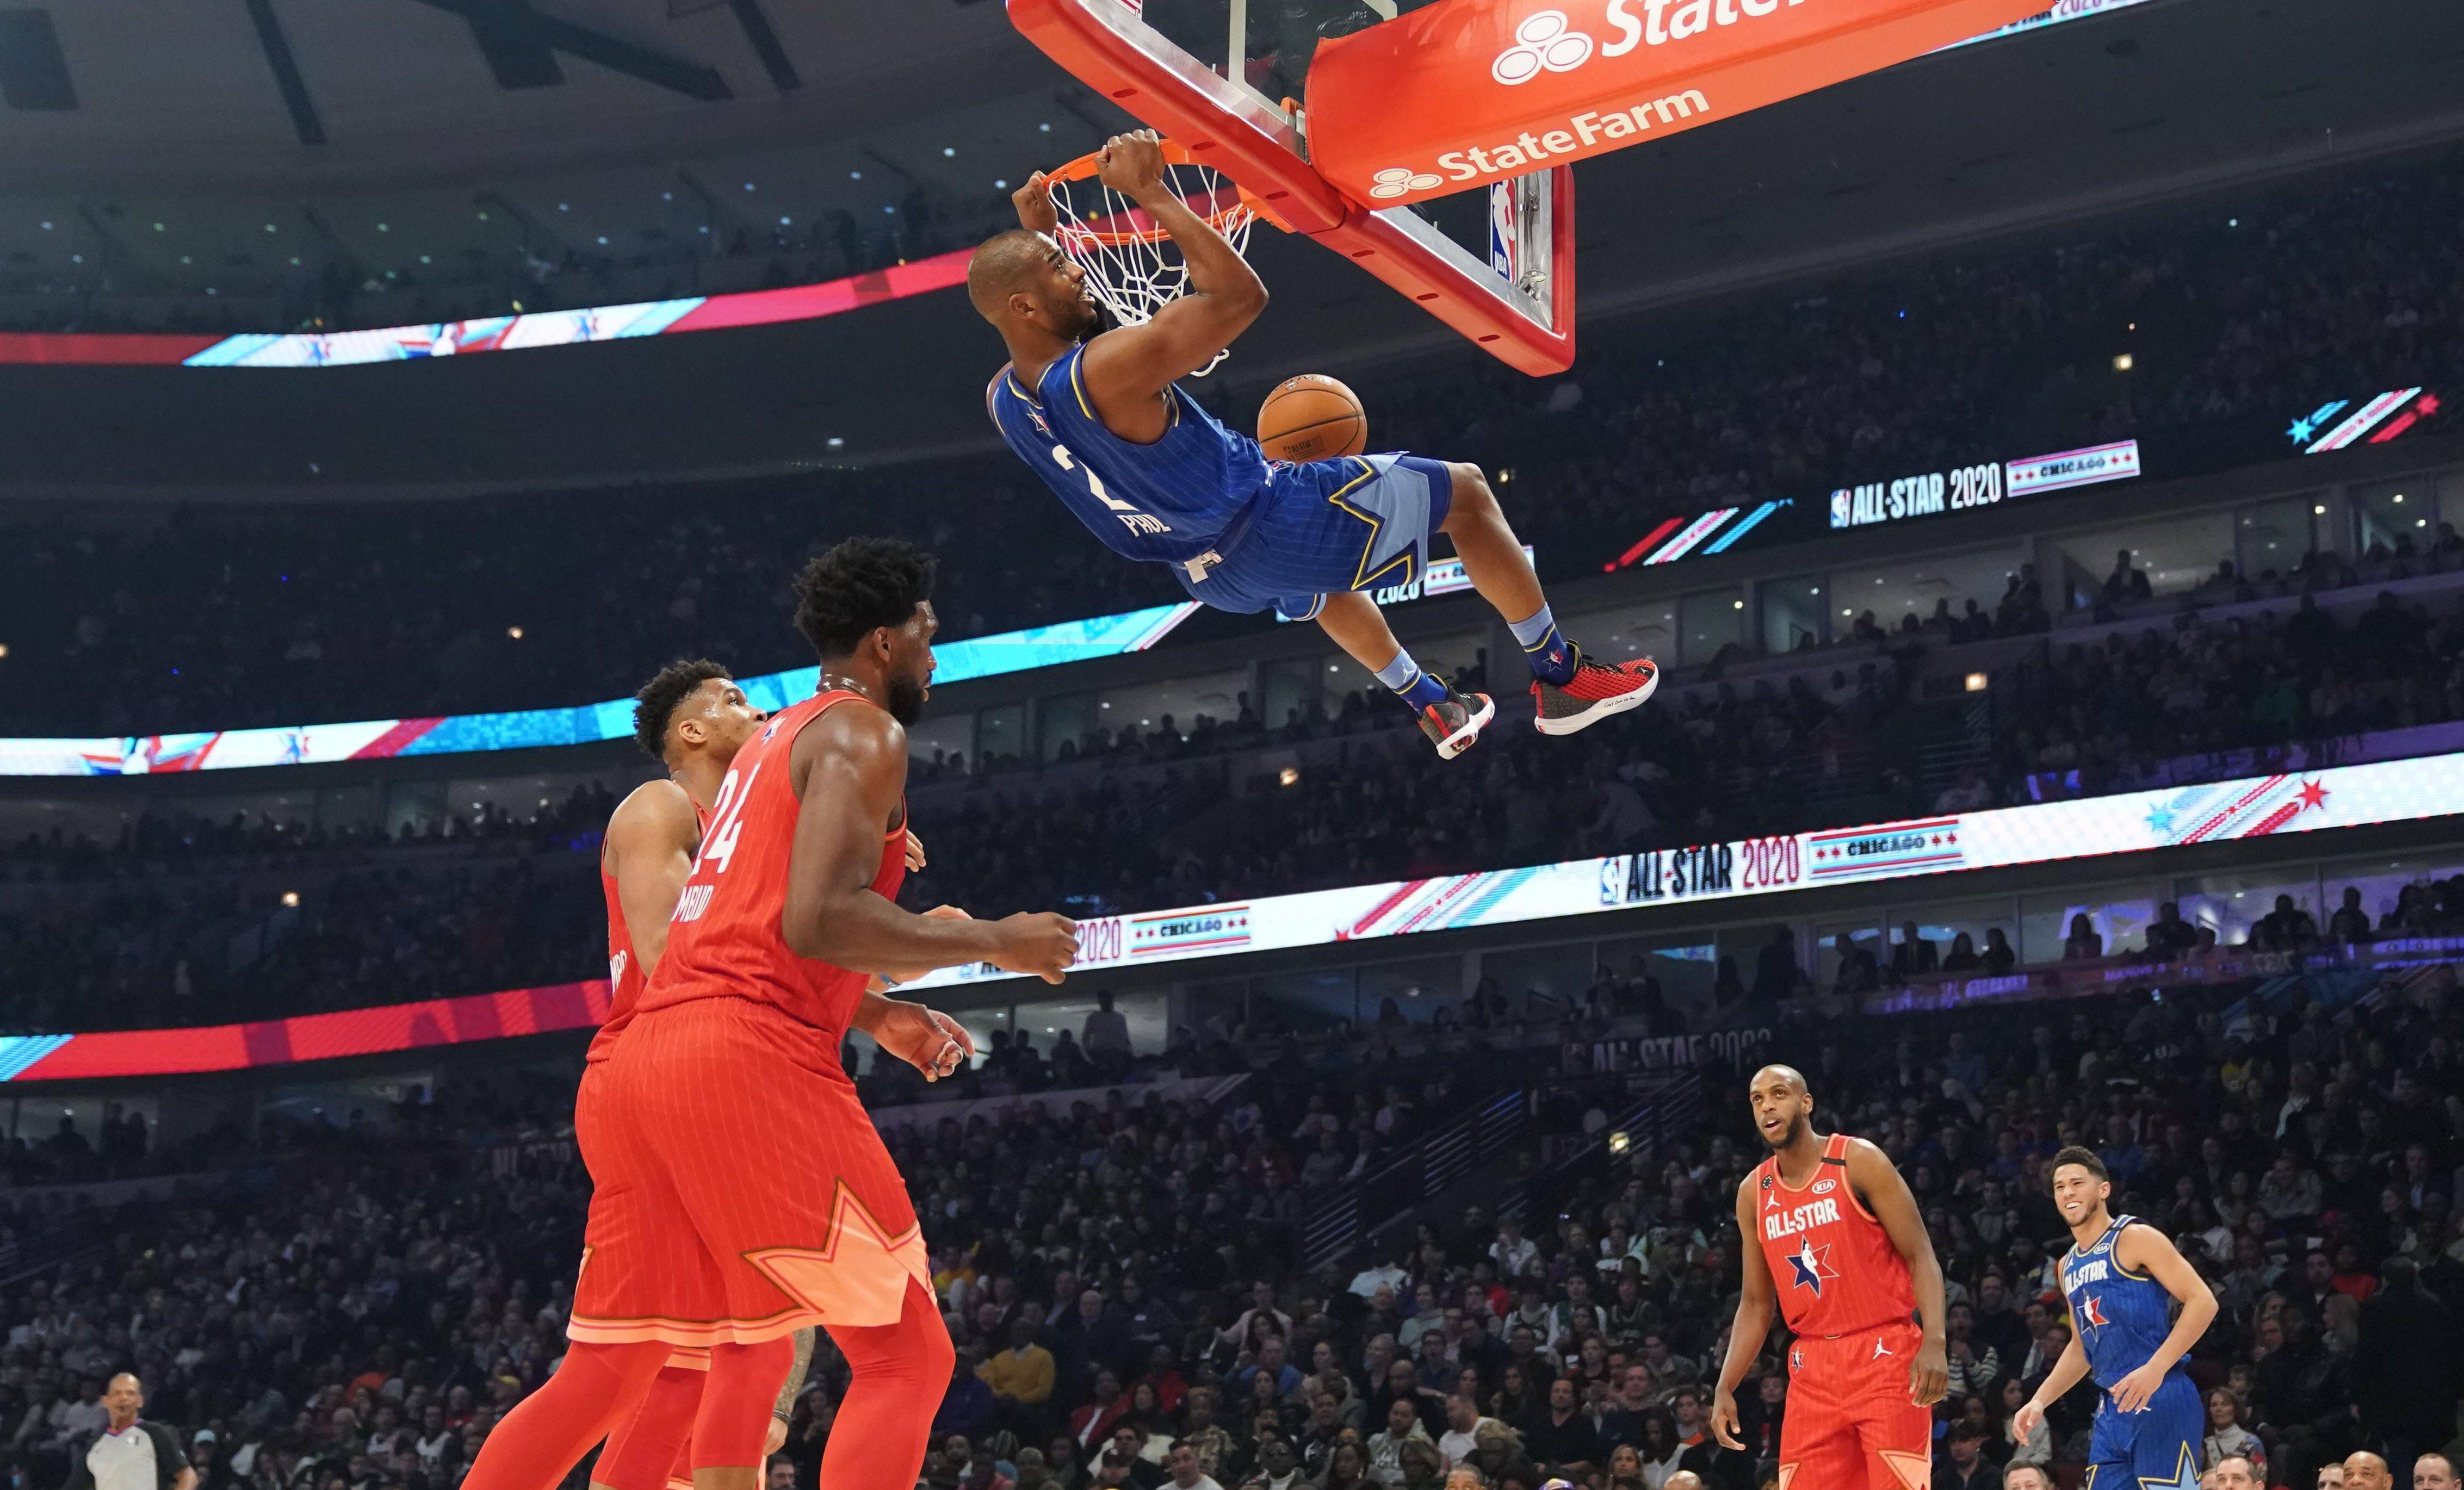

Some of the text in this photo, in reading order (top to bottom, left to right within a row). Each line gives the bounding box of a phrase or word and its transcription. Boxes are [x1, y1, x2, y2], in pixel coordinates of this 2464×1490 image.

[1052, 444, 1140, 512] 2
[1951, 462, 2001, 509] 2020
[2040, 456, 2106, 477] CHICAGO
[1117, 514, 1172, 537] PAUL
[689, 762, 762, 877] 24
[1742, 837, 1800, 887] 2020
[1848, 837, 1926, 856] CHICAGO
[670, 884, 714, 923] MBIID
[1075, 919, 1120, 964] 2020
[1161, 919, 1222, 936] CHICAGO
[1816, 1181, 1833, 1192] KIA
[1766, 1197, 1841, 1240] ALL-STAR
